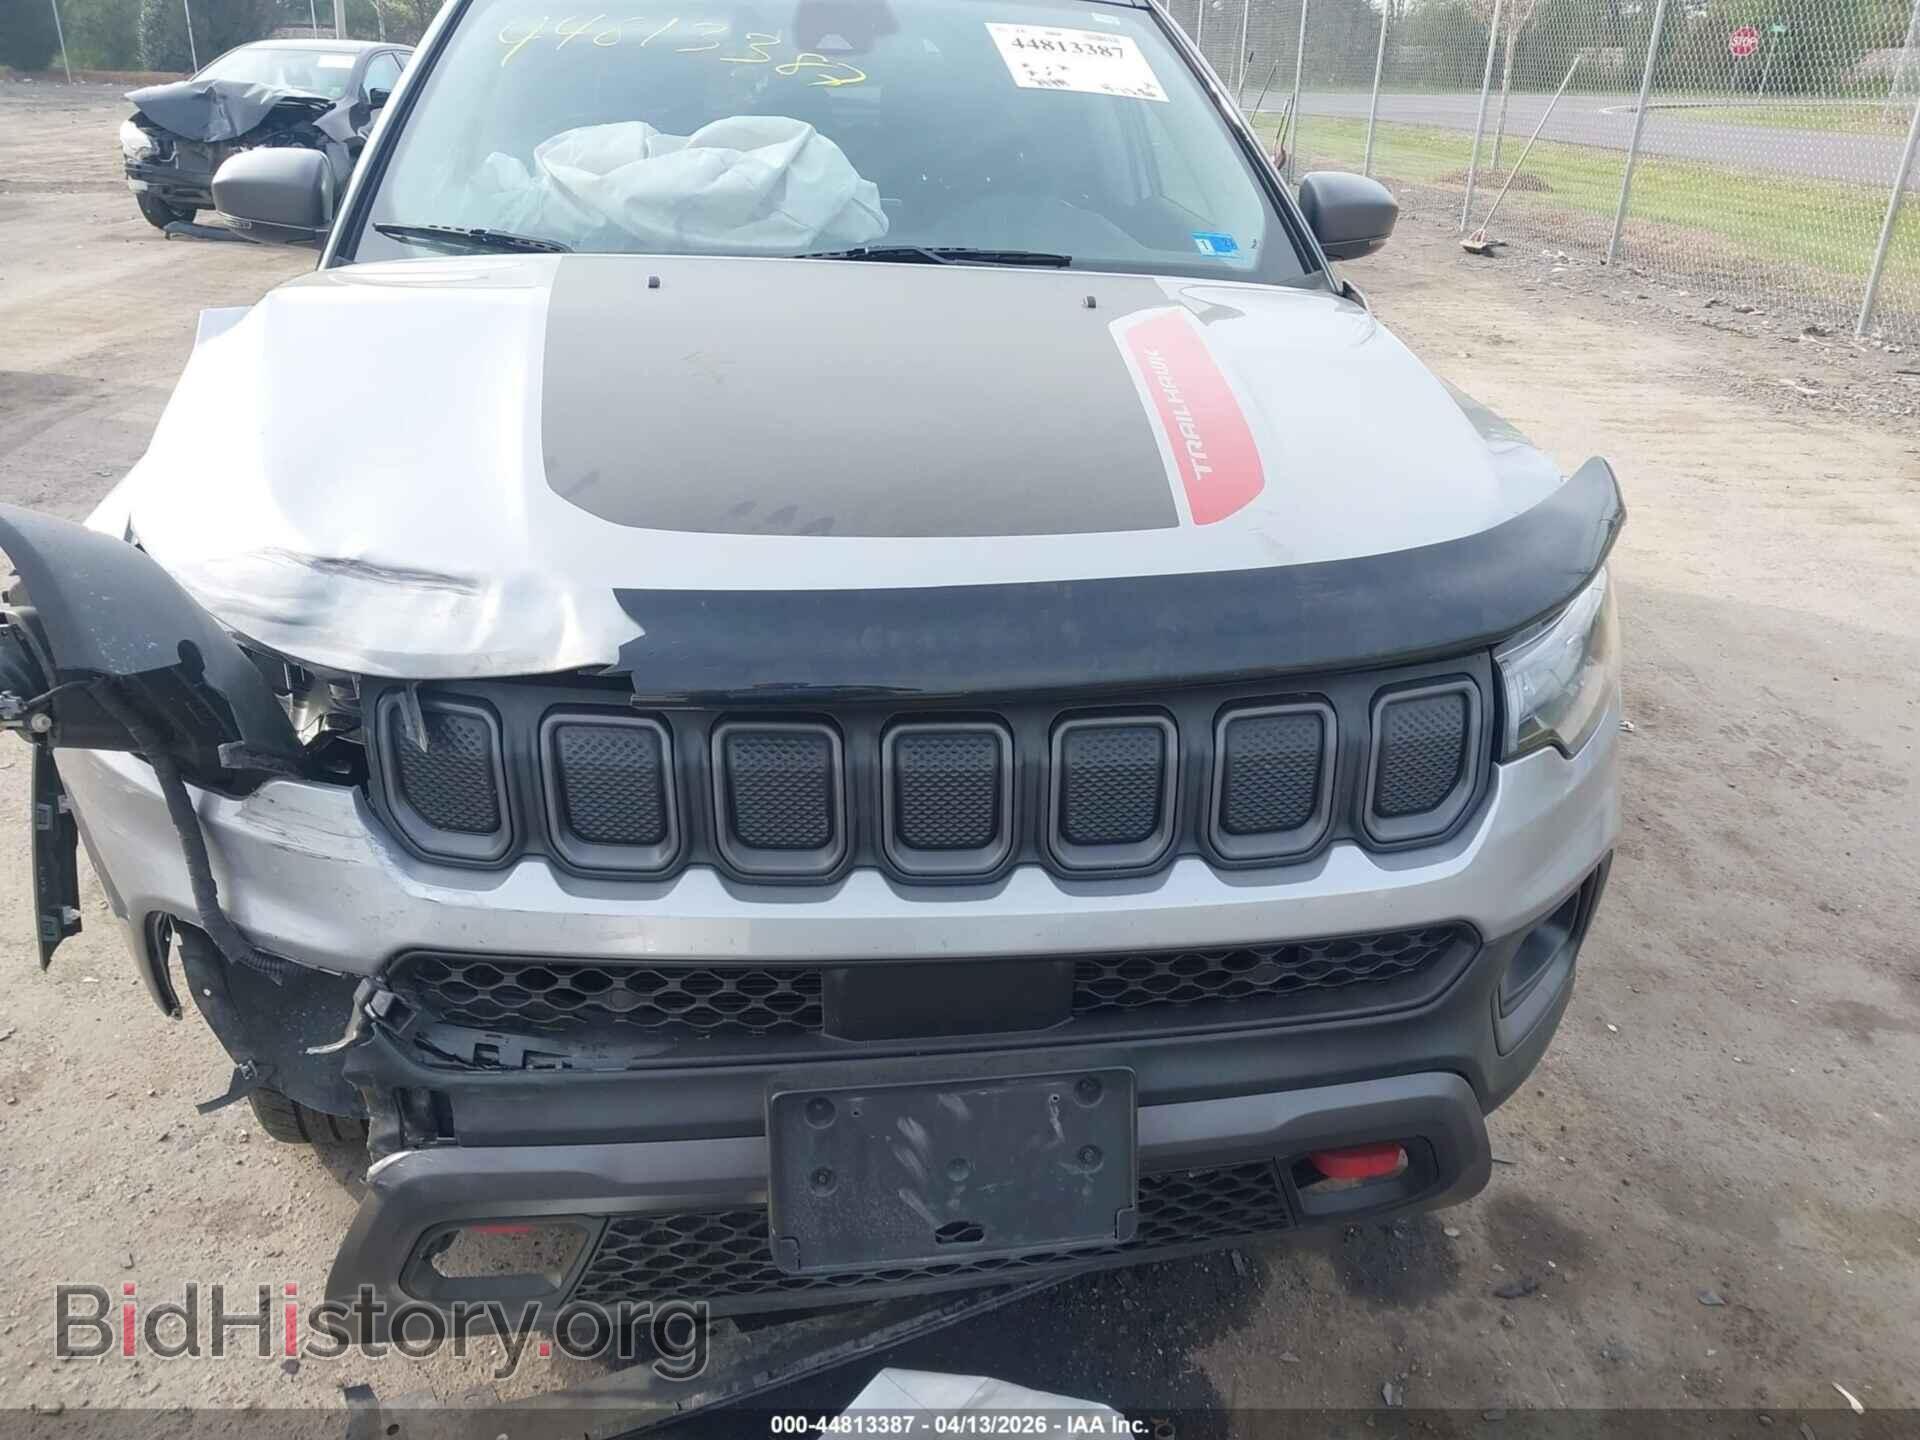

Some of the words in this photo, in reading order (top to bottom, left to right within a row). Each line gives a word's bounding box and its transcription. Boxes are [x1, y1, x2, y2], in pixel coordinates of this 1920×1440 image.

[1011, 37, 1124, 59] 44813387
[1731, 36, 1757, 48] STOP
[1144, 344, 1213, 481] TRAILHAWK
